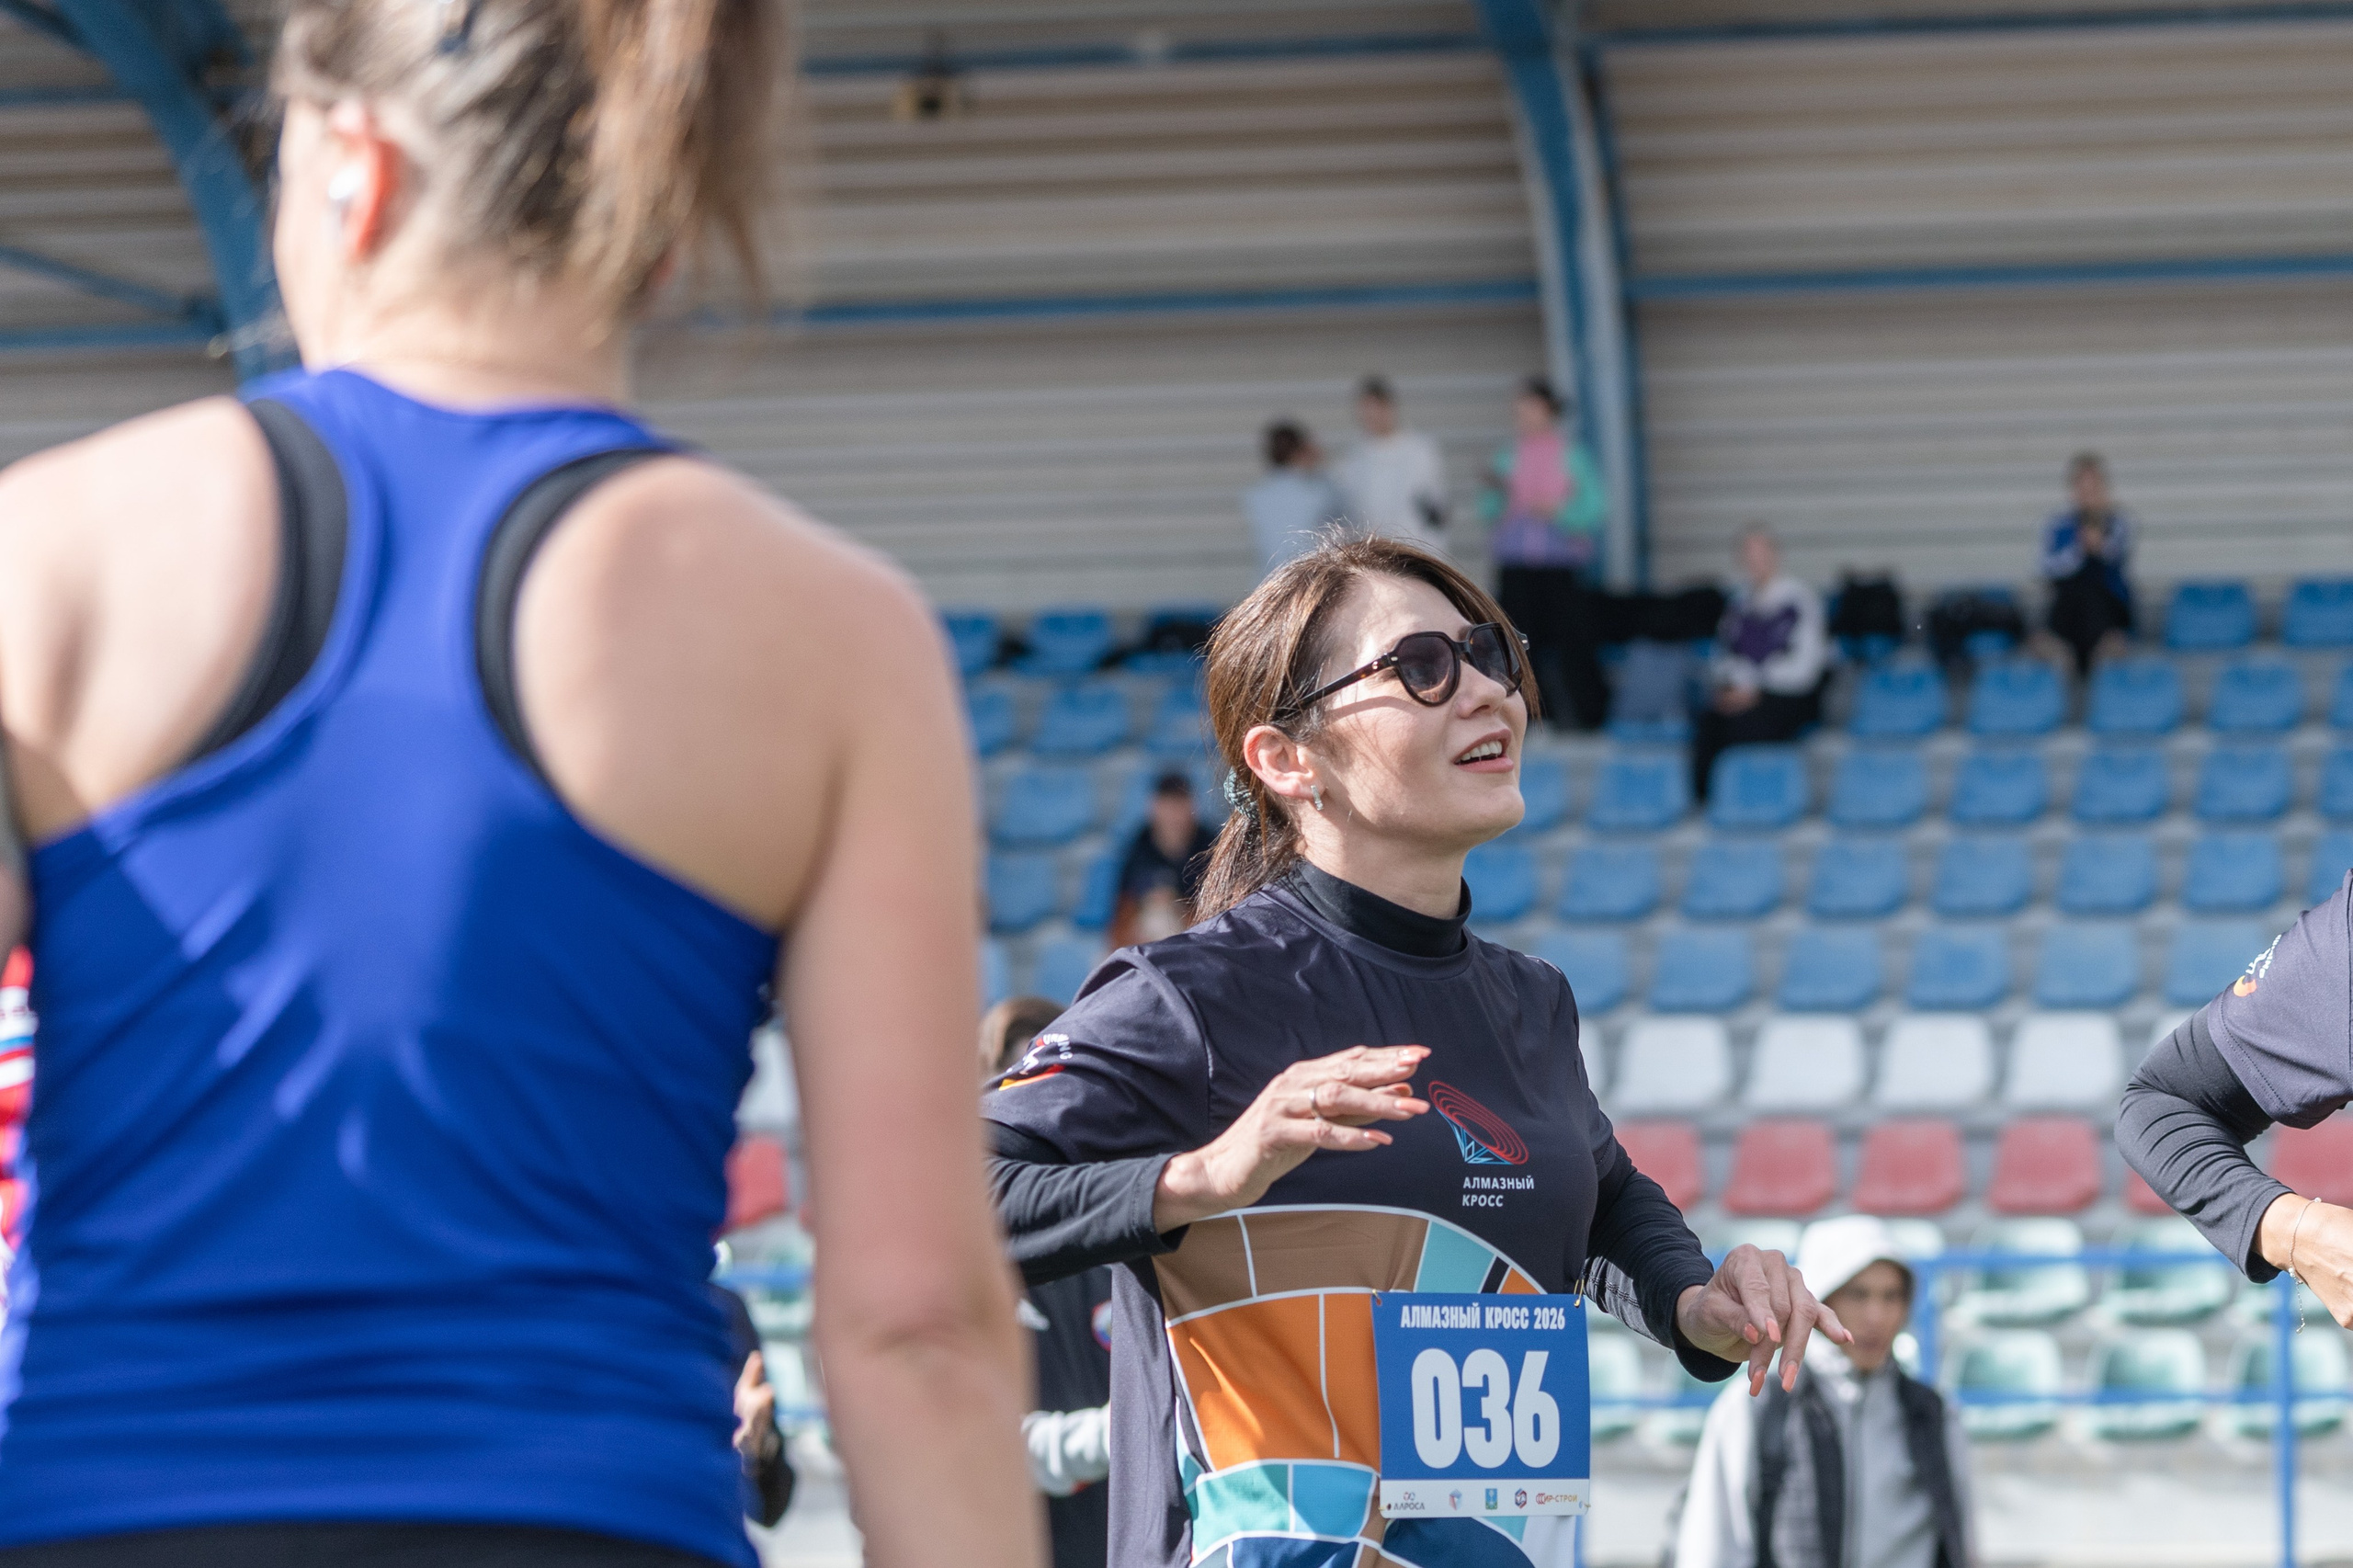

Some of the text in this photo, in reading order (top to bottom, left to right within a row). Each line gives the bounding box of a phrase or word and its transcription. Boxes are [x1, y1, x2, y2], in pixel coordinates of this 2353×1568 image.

[1462, 1175, 1535, 1189] АЛМАЗНЫЙ
[1461, 1194, 1504, 1207] КРОСС
[1401, 1303, 1565, 1330] АЛМАЗНЫЙ КРОСС 2026
[1411, 1347, 1560, 1469] 036
